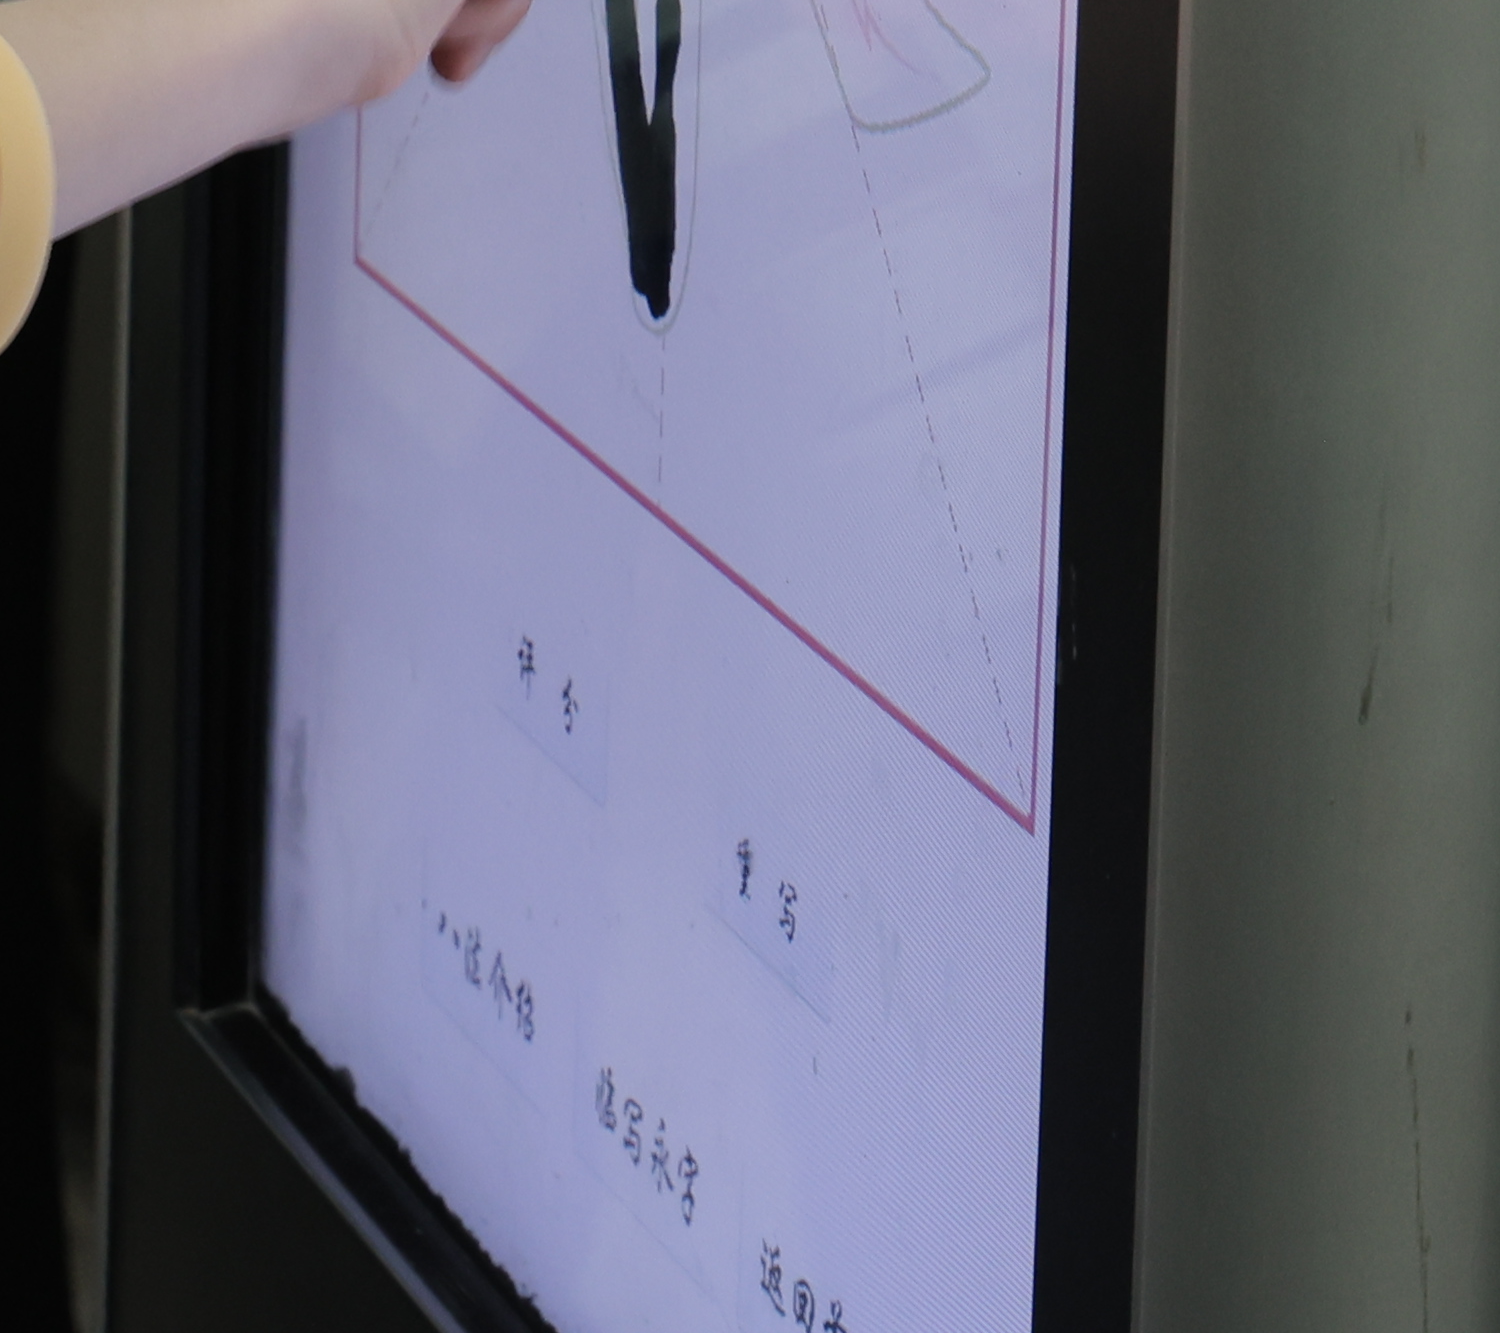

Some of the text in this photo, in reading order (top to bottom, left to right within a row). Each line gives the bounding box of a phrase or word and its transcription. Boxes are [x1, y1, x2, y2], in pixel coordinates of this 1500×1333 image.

[736, 838, 799, 942] 重写
[596, 1068, 700, 1226] 临写永字
